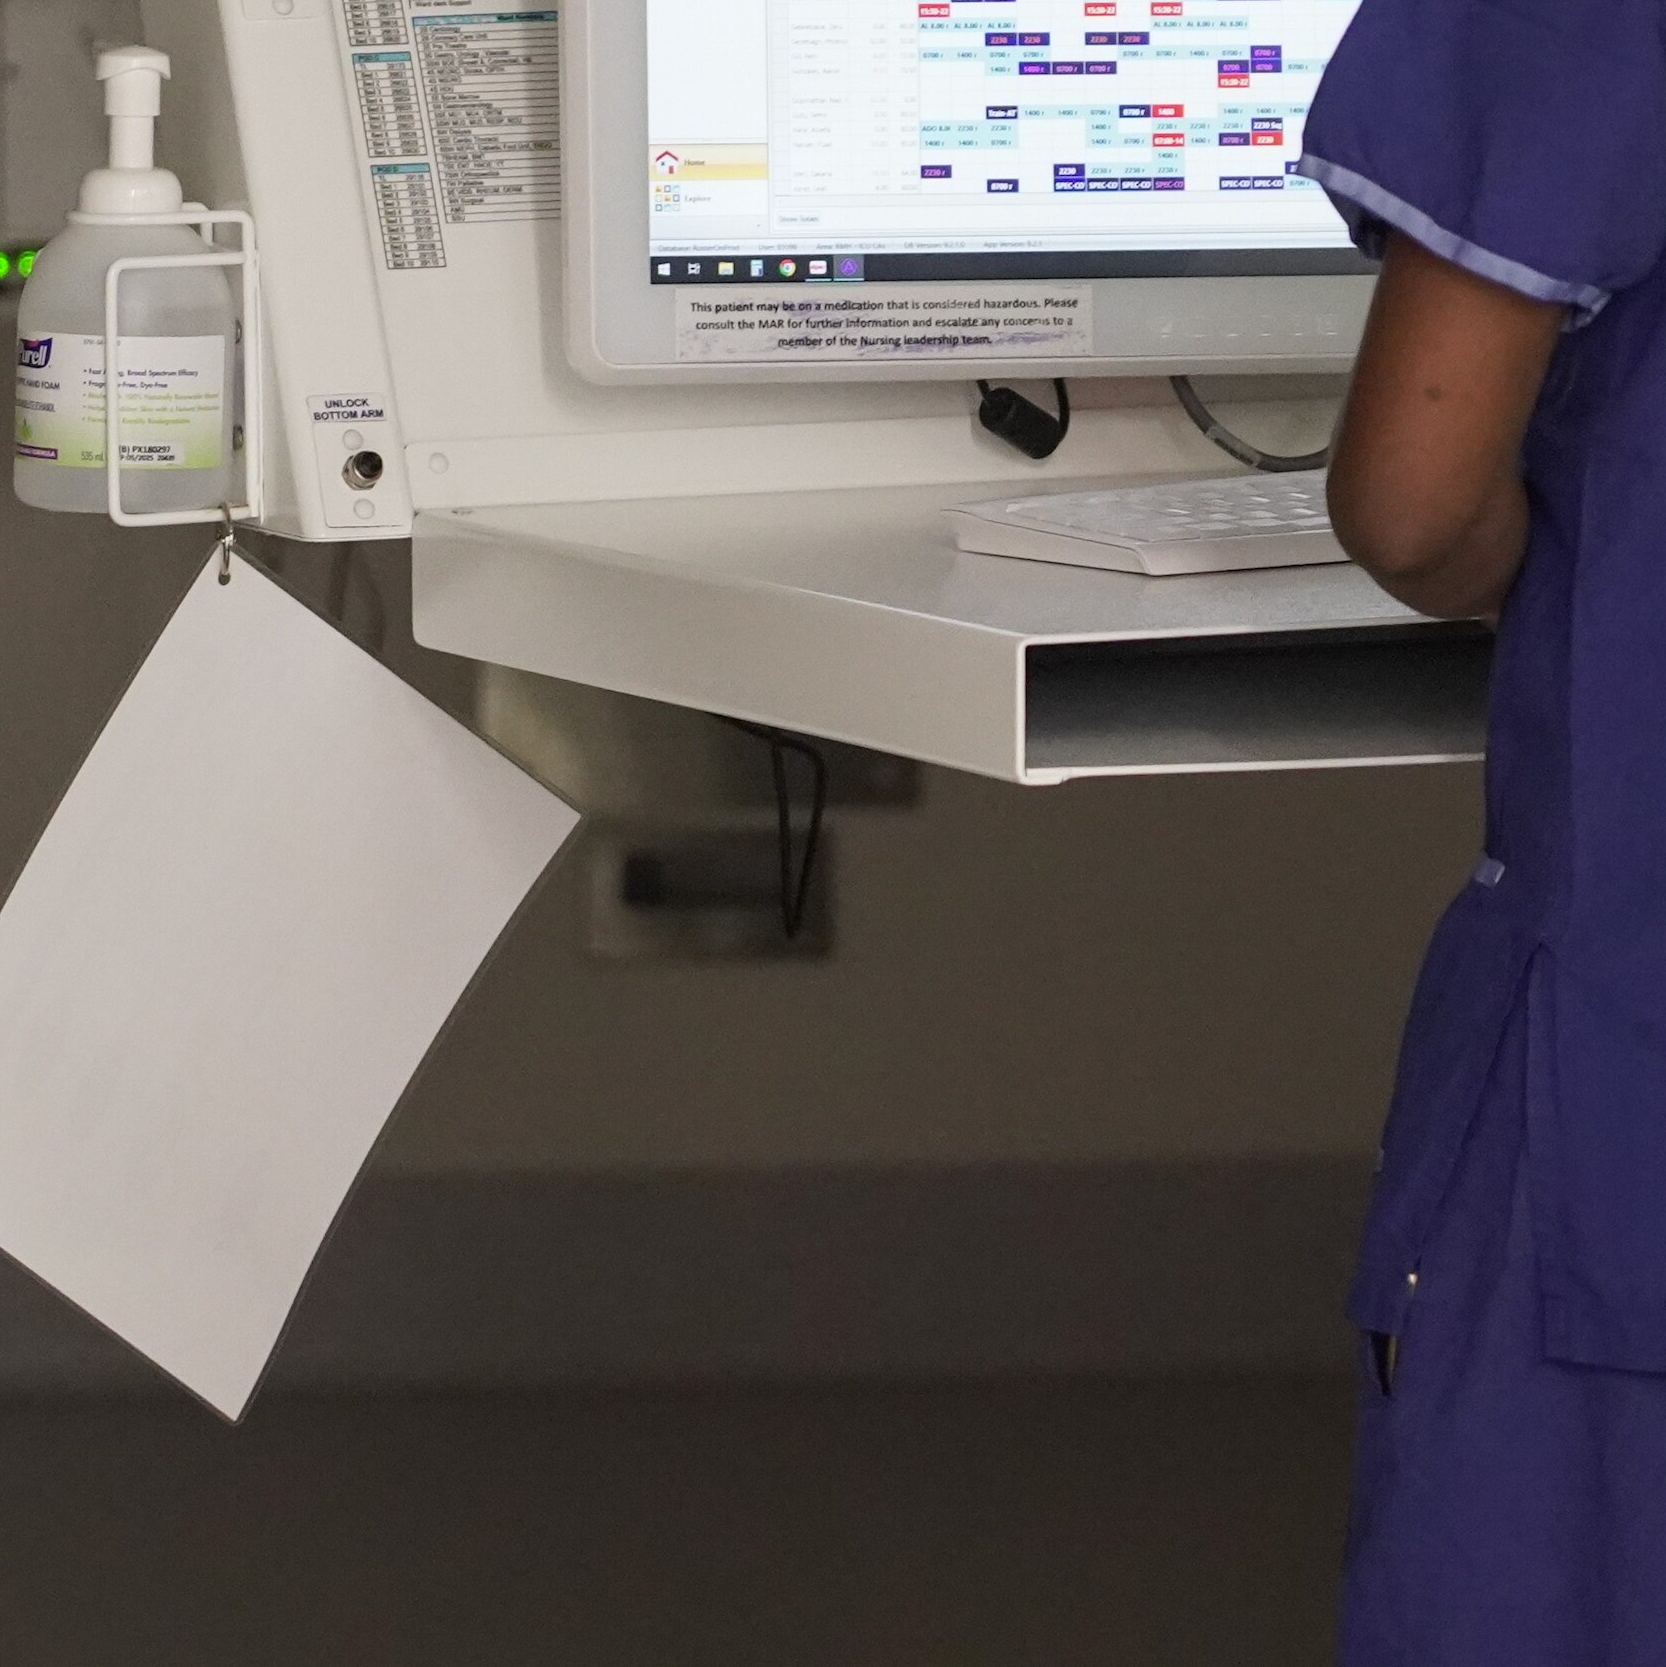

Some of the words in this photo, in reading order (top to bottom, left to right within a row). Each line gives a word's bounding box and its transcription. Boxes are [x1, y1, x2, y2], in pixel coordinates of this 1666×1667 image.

[684, 158, 706, 166] Home
[684, 195, 712, 204] Explore
[690, 302, 712, 312] This
[715, 302, 754, 314] patient
[756, 303, 779, 314] may
[782, 301, 797, 311] be
[798, 303, 812, 311] on
[815, 303, 821, 311] a
[824, 300, 884, 311] medication
[887, 300, 909, 310] that
[912, 300, 920, 310] is
[983, 299, 1041, 309] hazardous.
[1044, 298, 1079, 308] Please
[696, 320, 735, 330] consult
[737, 320, 756, 329] the
[758, 320, 784, 329] MAR
[787, 319, 803, 329] for
[805, 319, 843, 329] further
[912, 317, 933, 327] and
[935, 317, 979, 327] escalate
[981, 319, 1000, 329] any
[1053, 317, 1064, 326] to
[1067, 318, 1073, 326] a
[825, 336, 837, 347] of
[839, 336, 857, 346] the
[860, 335, 902, 348] Nursing
[904, 335, 959, 347] leadership
[962, 336, 993, 345] team.
[325, 398, 370, 409] UNLOCK
[314, 410, 358, 422] BOTTOM
[360, 409, 385, 419] ARM
